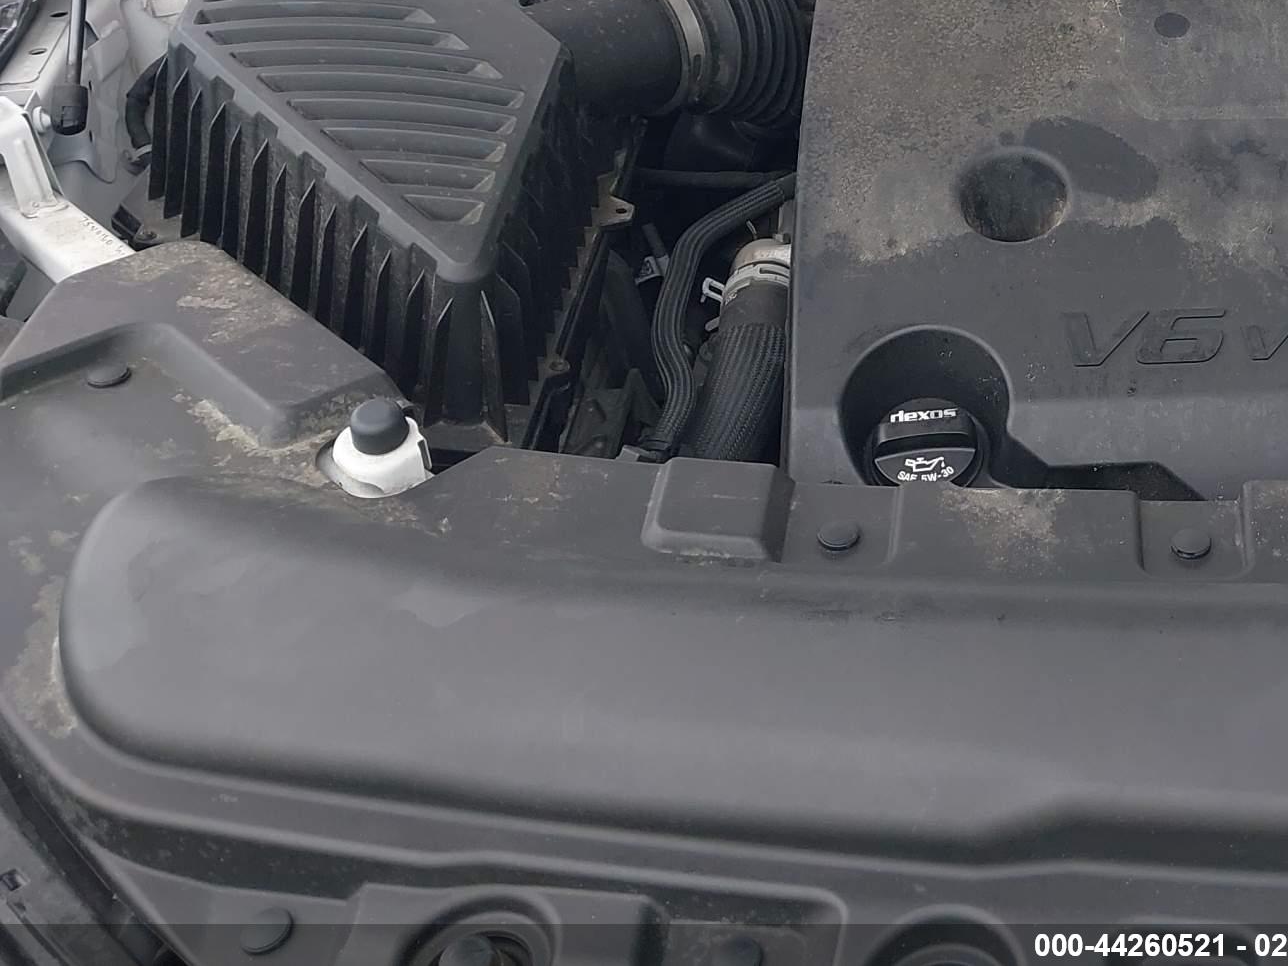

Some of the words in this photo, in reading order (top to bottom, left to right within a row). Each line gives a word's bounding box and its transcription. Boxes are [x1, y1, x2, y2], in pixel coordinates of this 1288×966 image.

[1061, 307, 1227, 366] V6
[890, 407, 959, 423] dexos
[921, 466, 954, 482] 5W-30
